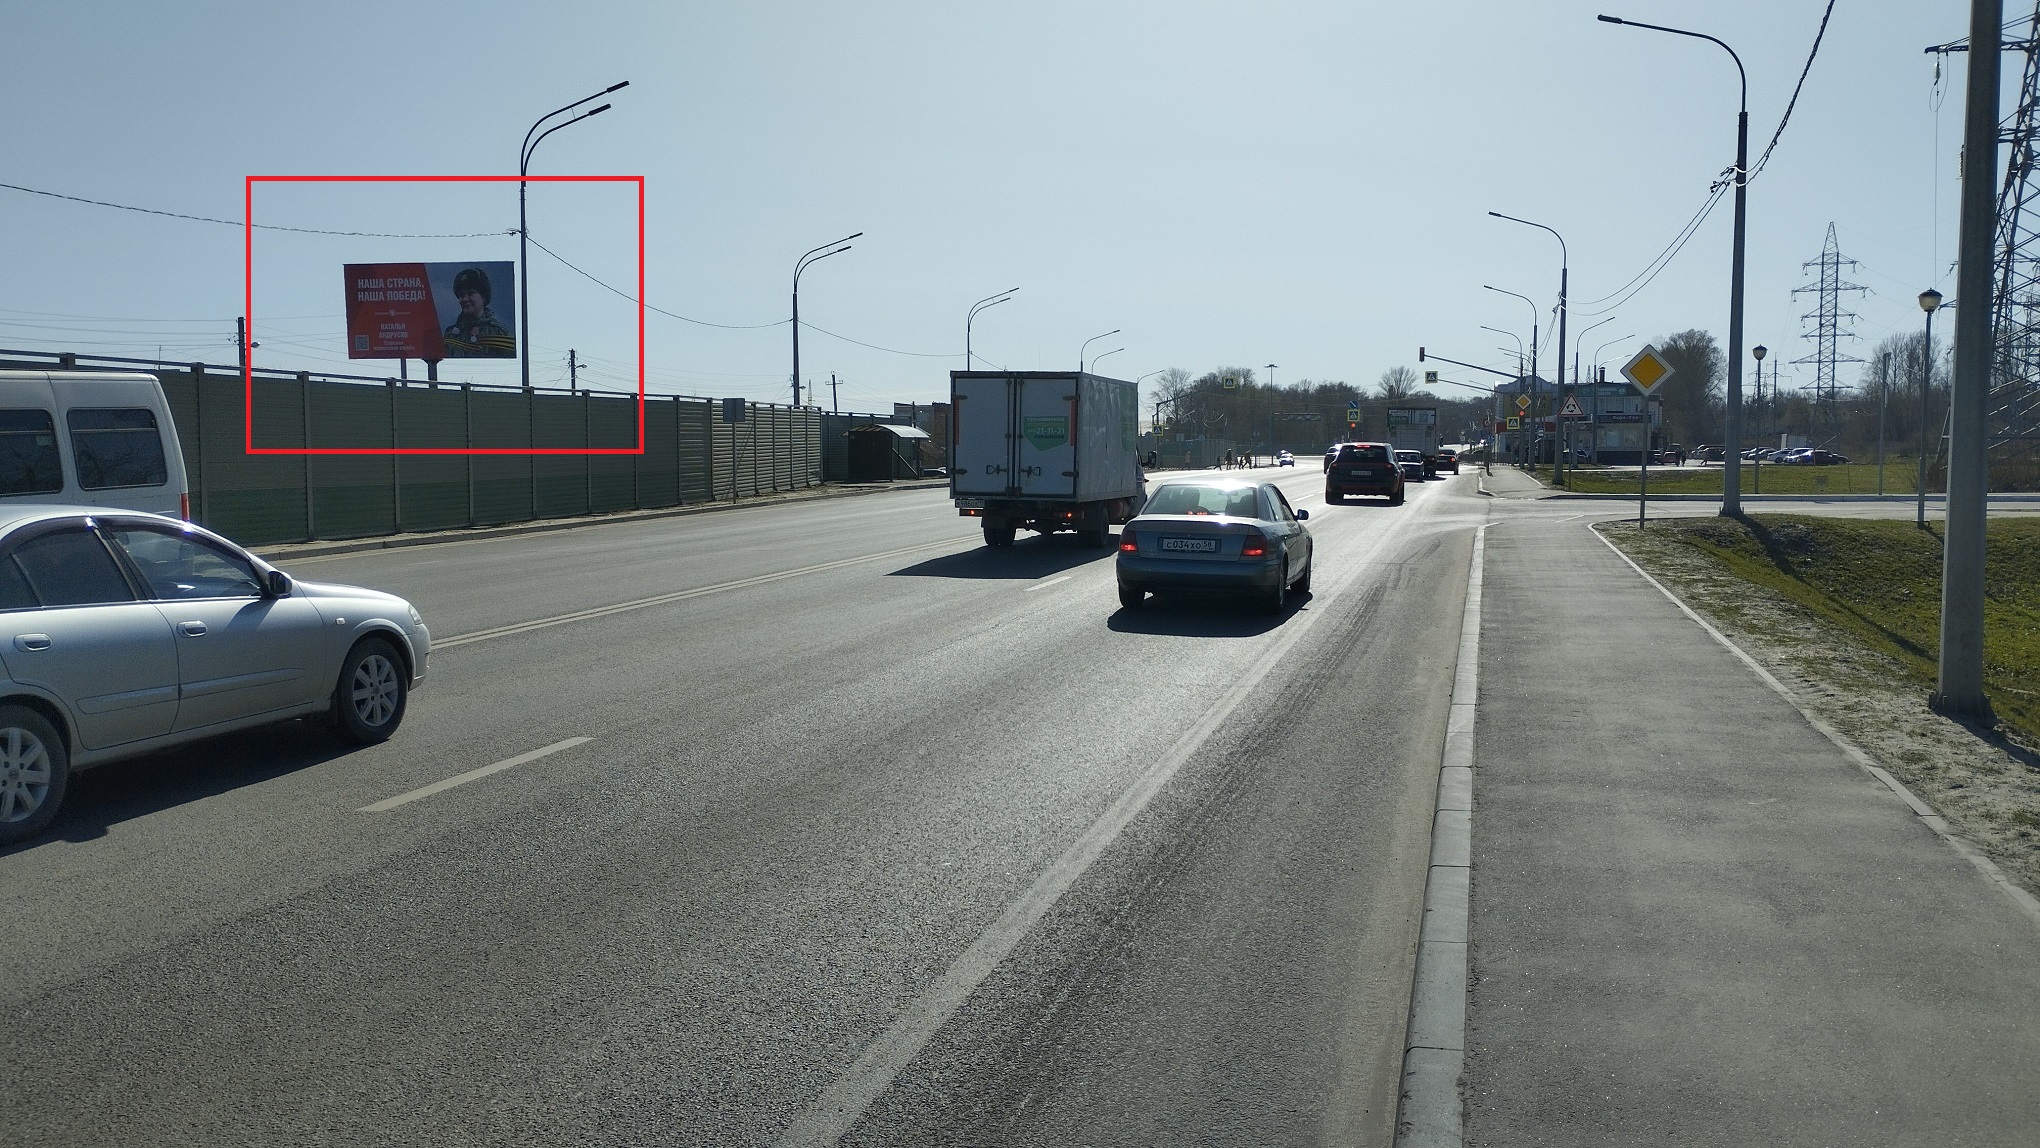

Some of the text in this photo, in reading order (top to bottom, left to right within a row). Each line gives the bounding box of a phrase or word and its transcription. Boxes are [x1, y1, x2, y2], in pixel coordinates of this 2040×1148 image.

[358, 278, 424, 288] НАША СТРАНА,
[358, 290, 426, 302] НАША ПОБЕДА!
